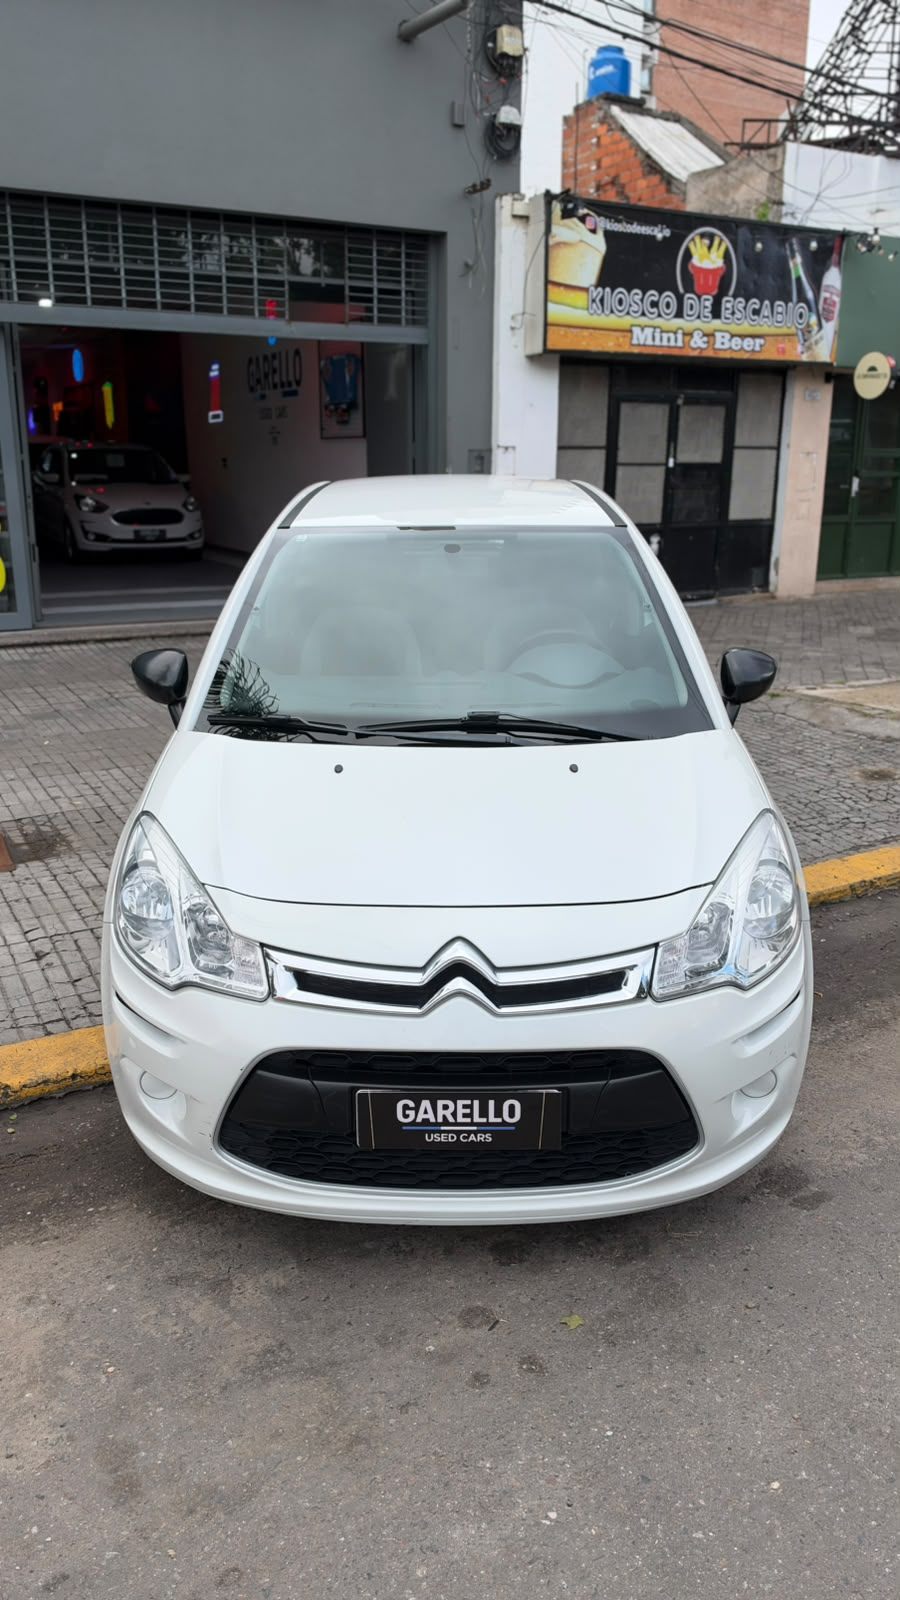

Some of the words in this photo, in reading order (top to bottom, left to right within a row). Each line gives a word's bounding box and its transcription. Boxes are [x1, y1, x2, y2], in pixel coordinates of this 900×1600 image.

[588, 286, 677, 319] KIOSCO
[683, 293, 713, 322] DE
[721, 296, 809, 328] ESCABIO
[631, 326, 684, 347] Mini
[690, 330, 708, 348] &
[714, 331, 765, 352] Beer
[246, 348, 303, 393] GARELLO
[396, 1099, 521, 1123] GARELLO
[425, 1133, 457, 1142] USED
[459, 1133, 492, 1142] CARS
